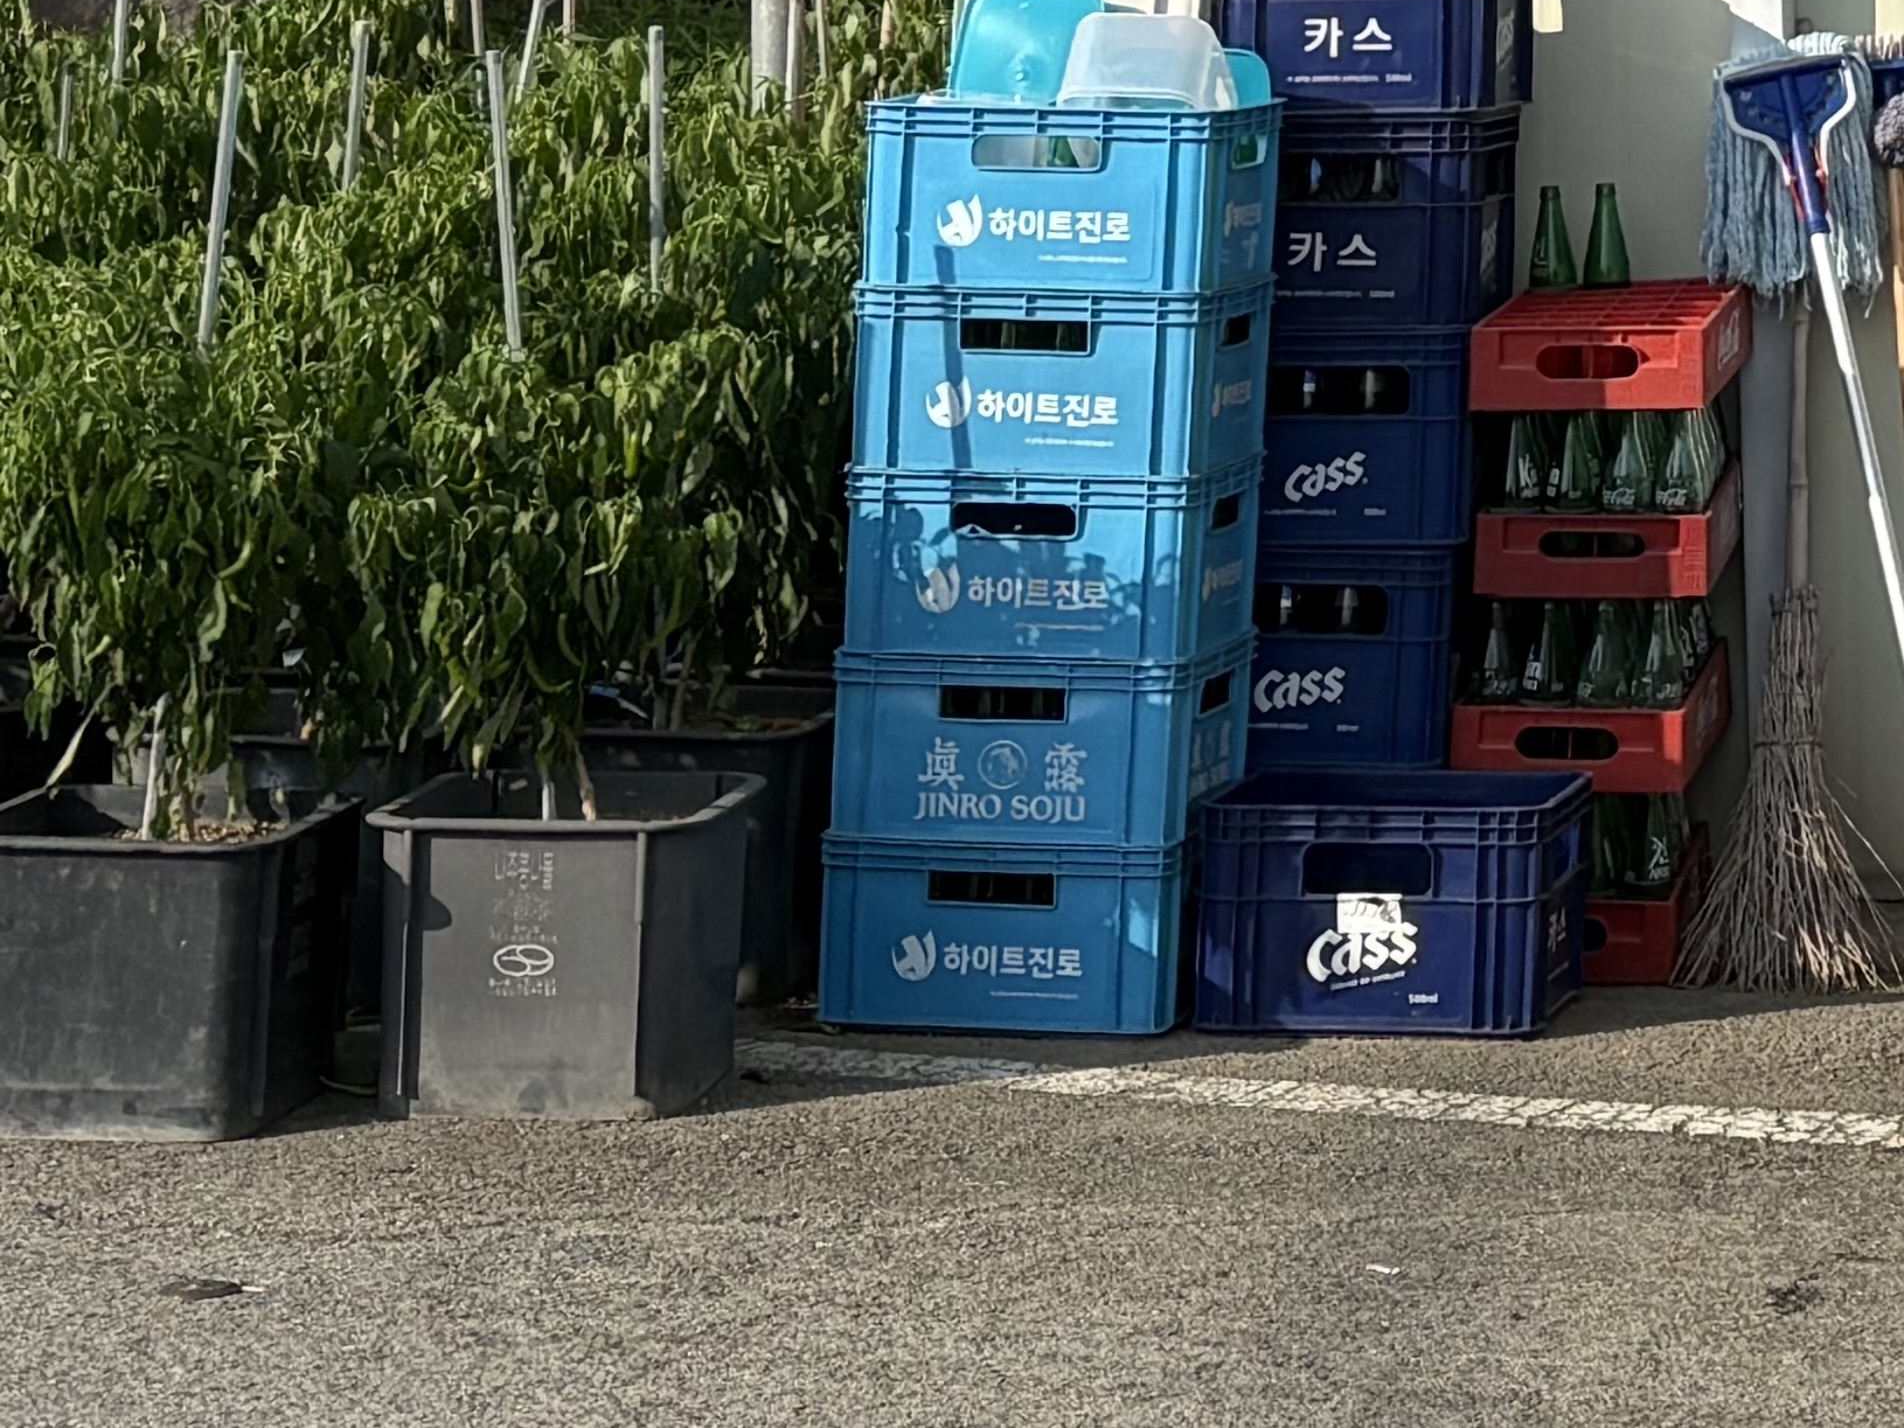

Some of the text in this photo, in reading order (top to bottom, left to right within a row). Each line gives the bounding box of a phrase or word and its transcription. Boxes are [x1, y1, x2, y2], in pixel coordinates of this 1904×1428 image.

[1304, 16, 1393, 58] 카스
[988, 207, 1131, 244] 하이트진로
[1287, 232, 1377, 272] 카스
[977, 388, 1118, 427] 하이트진로
[967, 575, 1109, 610] 하이트진로
[913, 792, 1085, 823] JINRO SOJU
[943, 942, 1082, 979] 하이트진로
